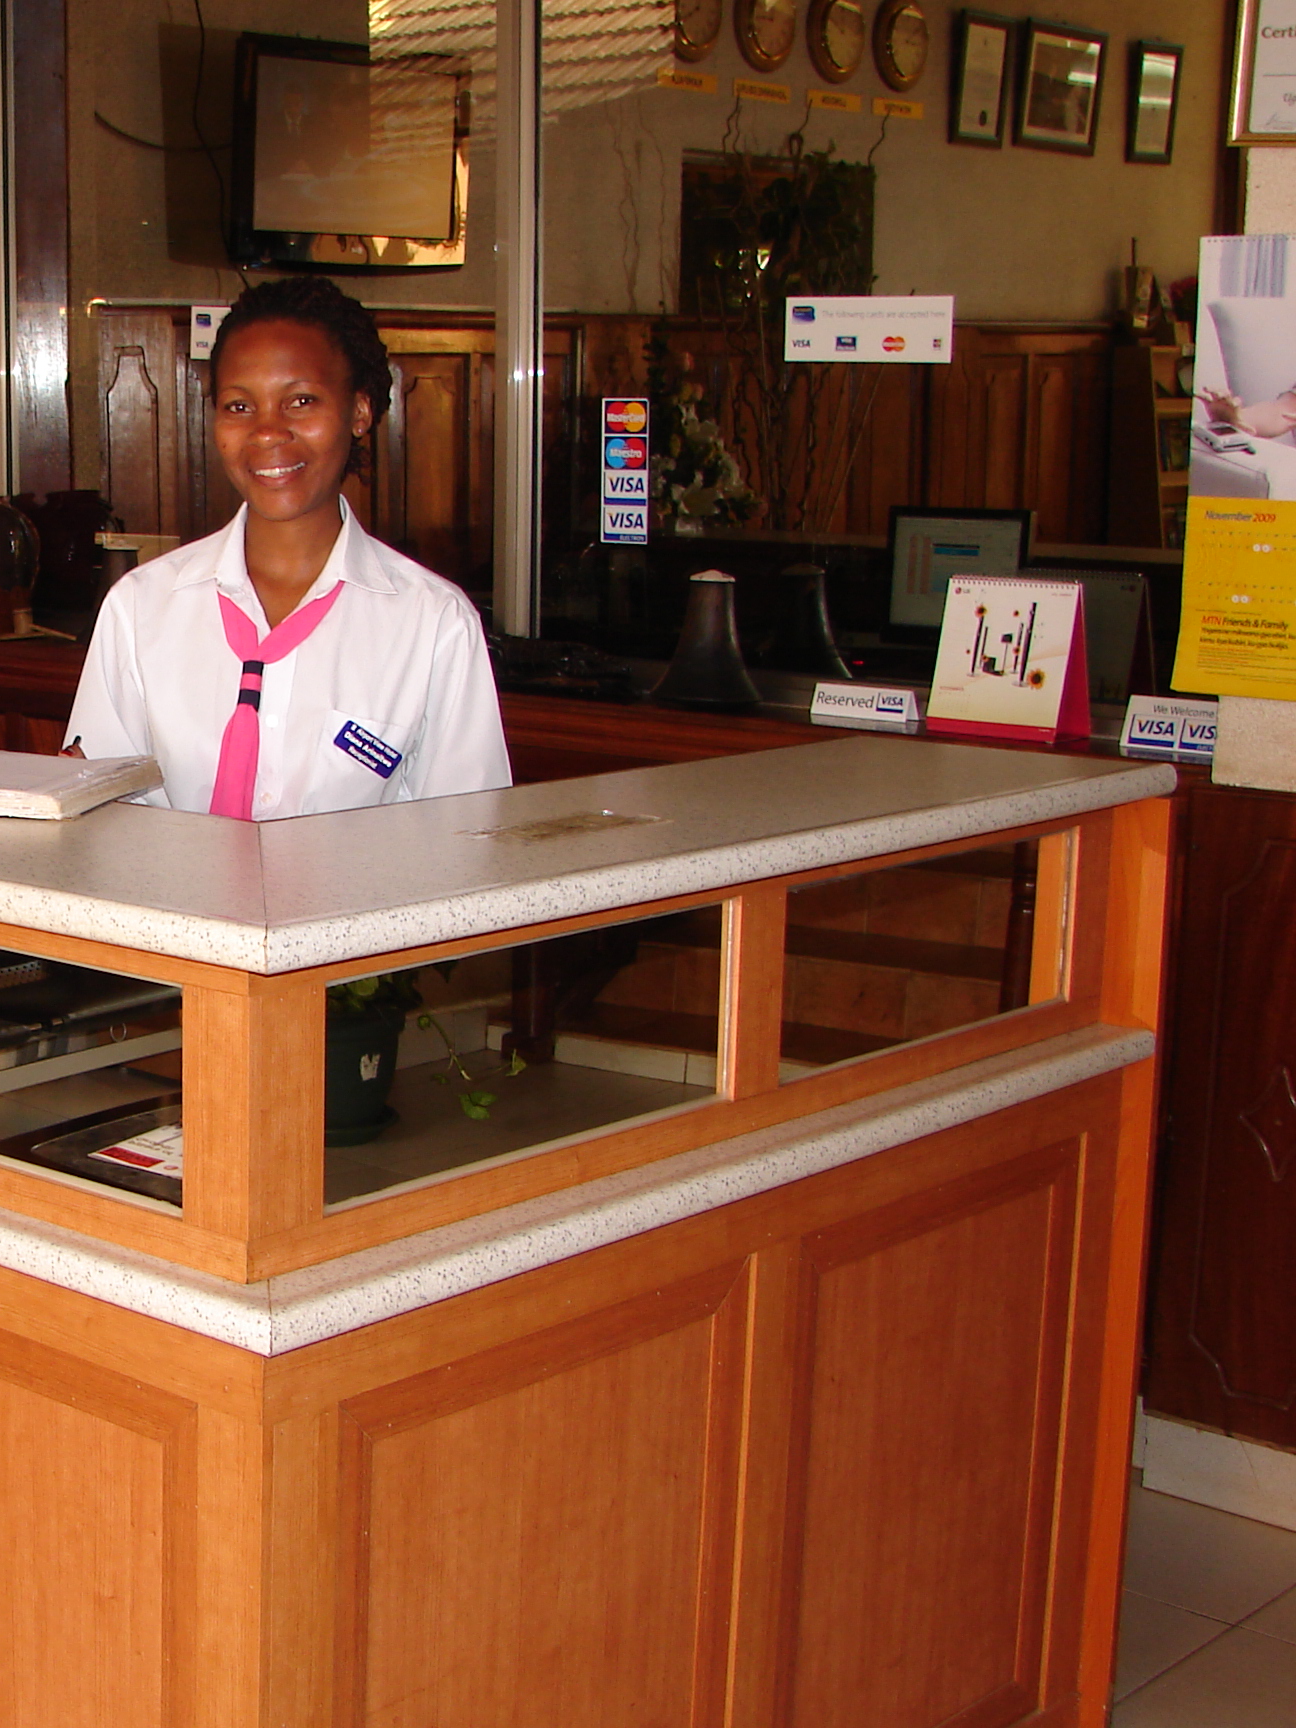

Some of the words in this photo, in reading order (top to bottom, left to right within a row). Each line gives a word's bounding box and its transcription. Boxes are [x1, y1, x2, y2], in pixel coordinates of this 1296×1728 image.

[792, 339, 811, 348] VISA
[609, 447, 642, 459] Maestro
[608, 477, 644, 493] VISA
[608, 513, 644, 529] VISA
[1252, 513, 1277, 523] 2009
[1201, 615, 1222, 626] MTN
[816, 690, 874, 709] Reserved
[881, 696, 904, 707] VISA
[1153, 704, 1168, 715] We
[1170, 705, 1215, 718] Welcome
[1136, 719, 1175, 736] VISA
[1188, 724, 1217, 740] VIS
